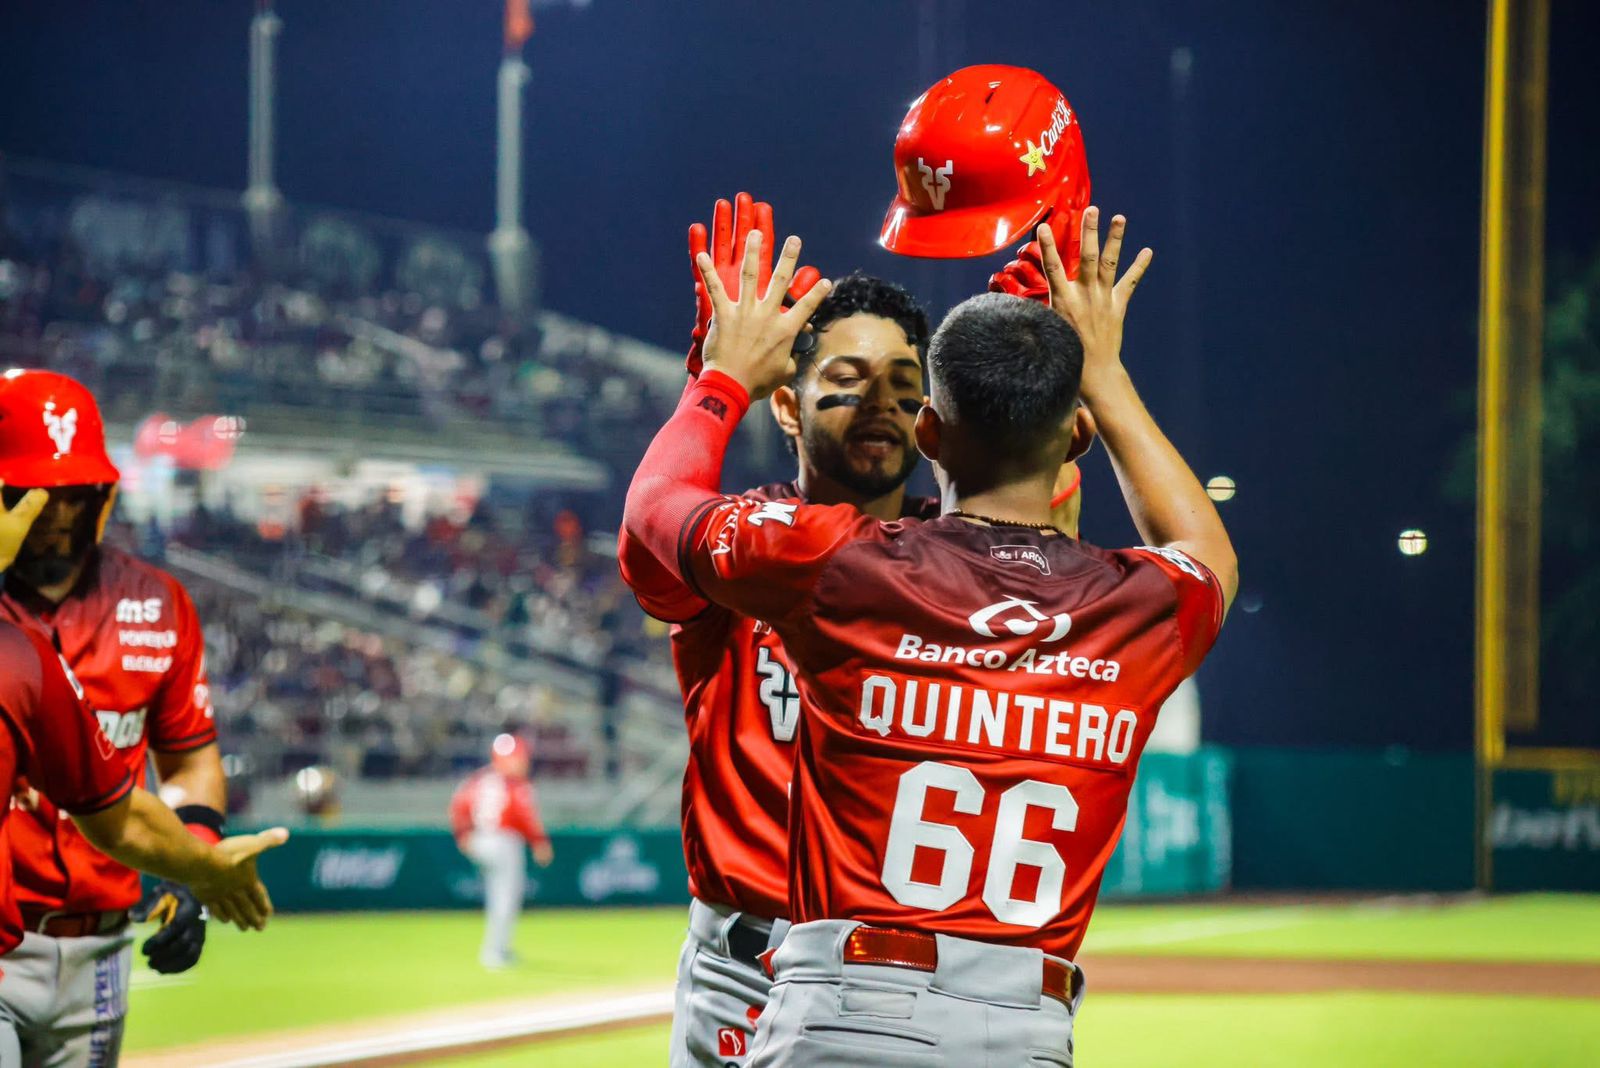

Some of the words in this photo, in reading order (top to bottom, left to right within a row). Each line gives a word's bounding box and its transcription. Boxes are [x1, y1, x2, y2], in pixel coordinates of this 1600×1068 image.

[894, 633, 1007, 669] Banco
[1008, 648, 1120, 683] Azteca
[860, 675, 1138, 764] QUINTERO
[880, 760, 1080, 928] 66
